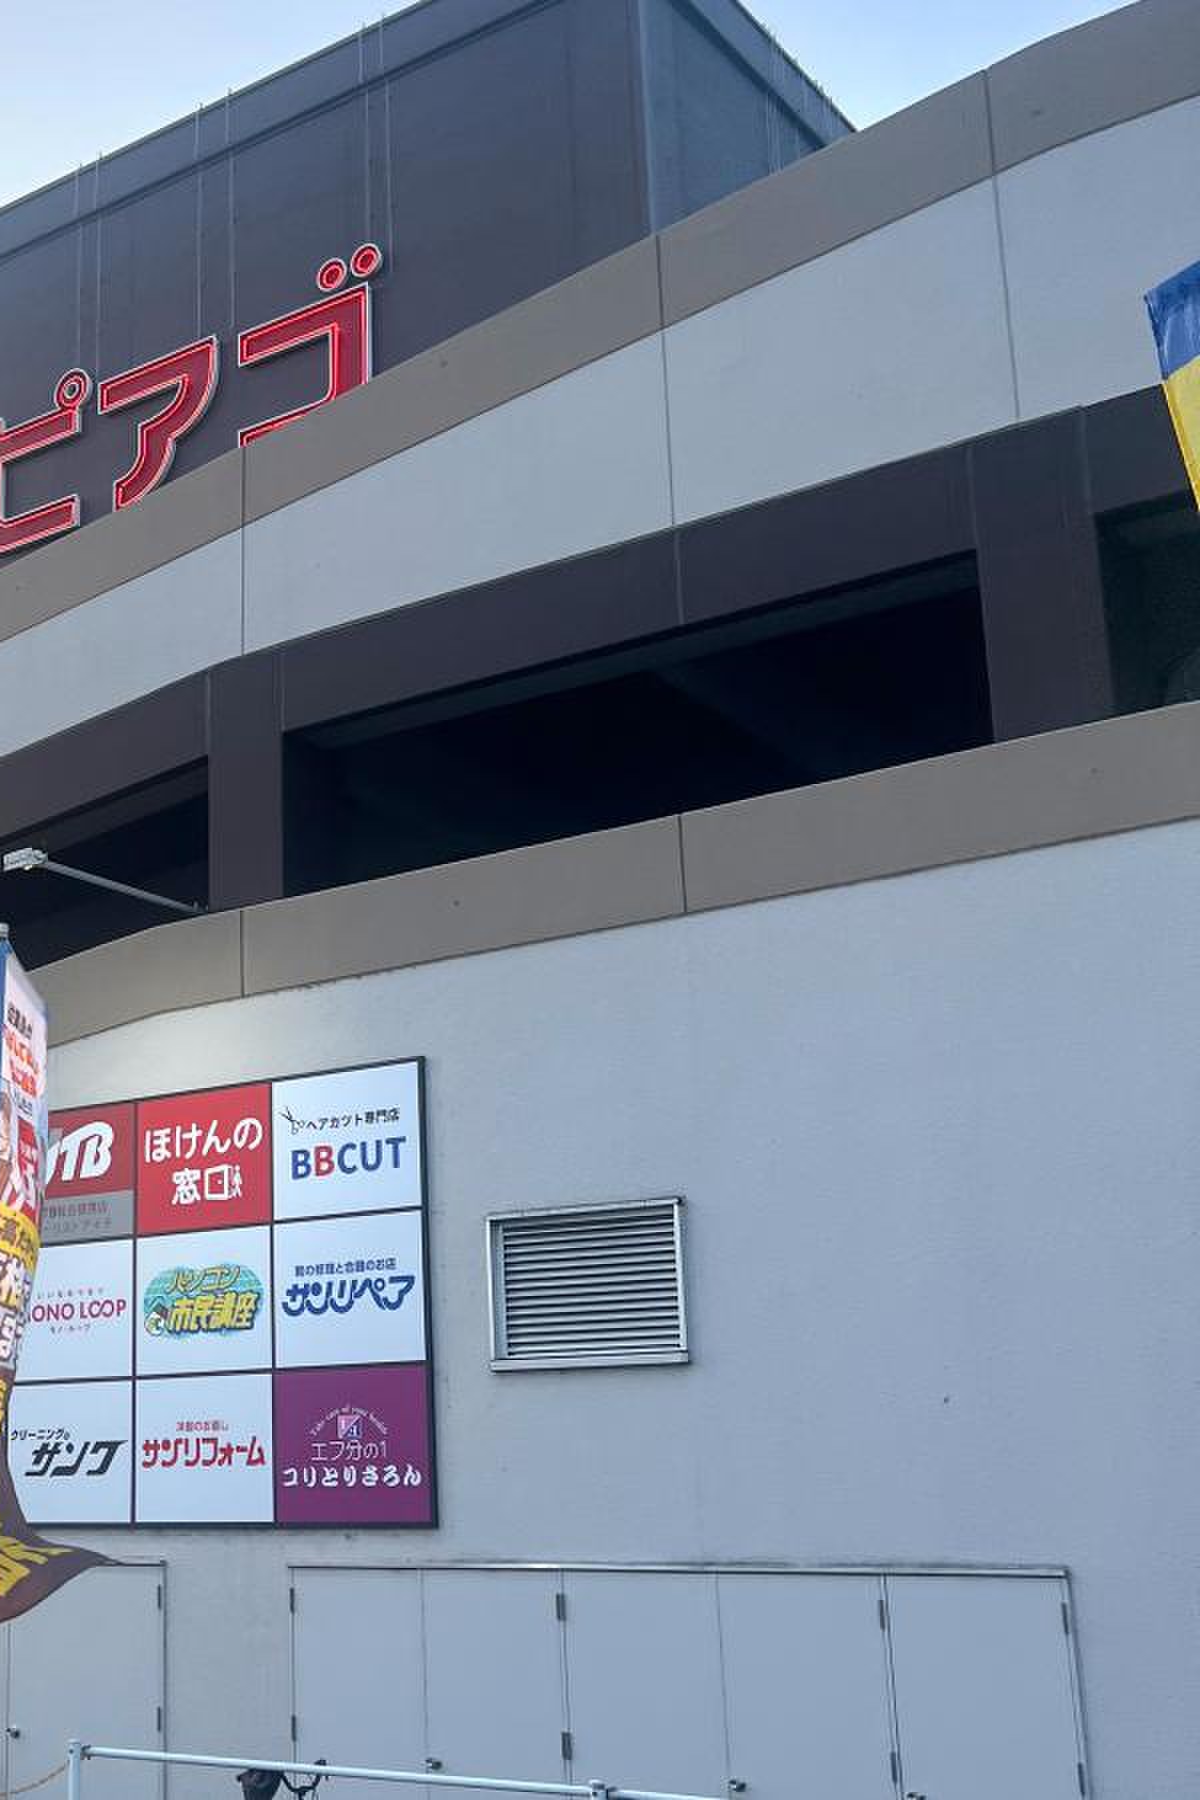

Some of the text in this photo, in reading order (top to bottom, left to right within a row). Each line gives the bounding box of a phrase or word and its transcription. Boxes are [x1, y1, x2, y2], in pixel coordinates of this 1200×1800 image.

[144, 1117, 264, 1164] ほけんの
[171, 1163, 234, 1206] 窓口
[164, 1265, 241, 1295] パソコン
[27, 1298, 127, 1322] ONO LOOP
[281, 1275, 416, 1317] サンリペア
[141, 1435, 267, 1468] サンリフォーム
[310, 1440, 388, 1461] エフ分の1
[282, 1463, 423, 1488] コリとりさろん
